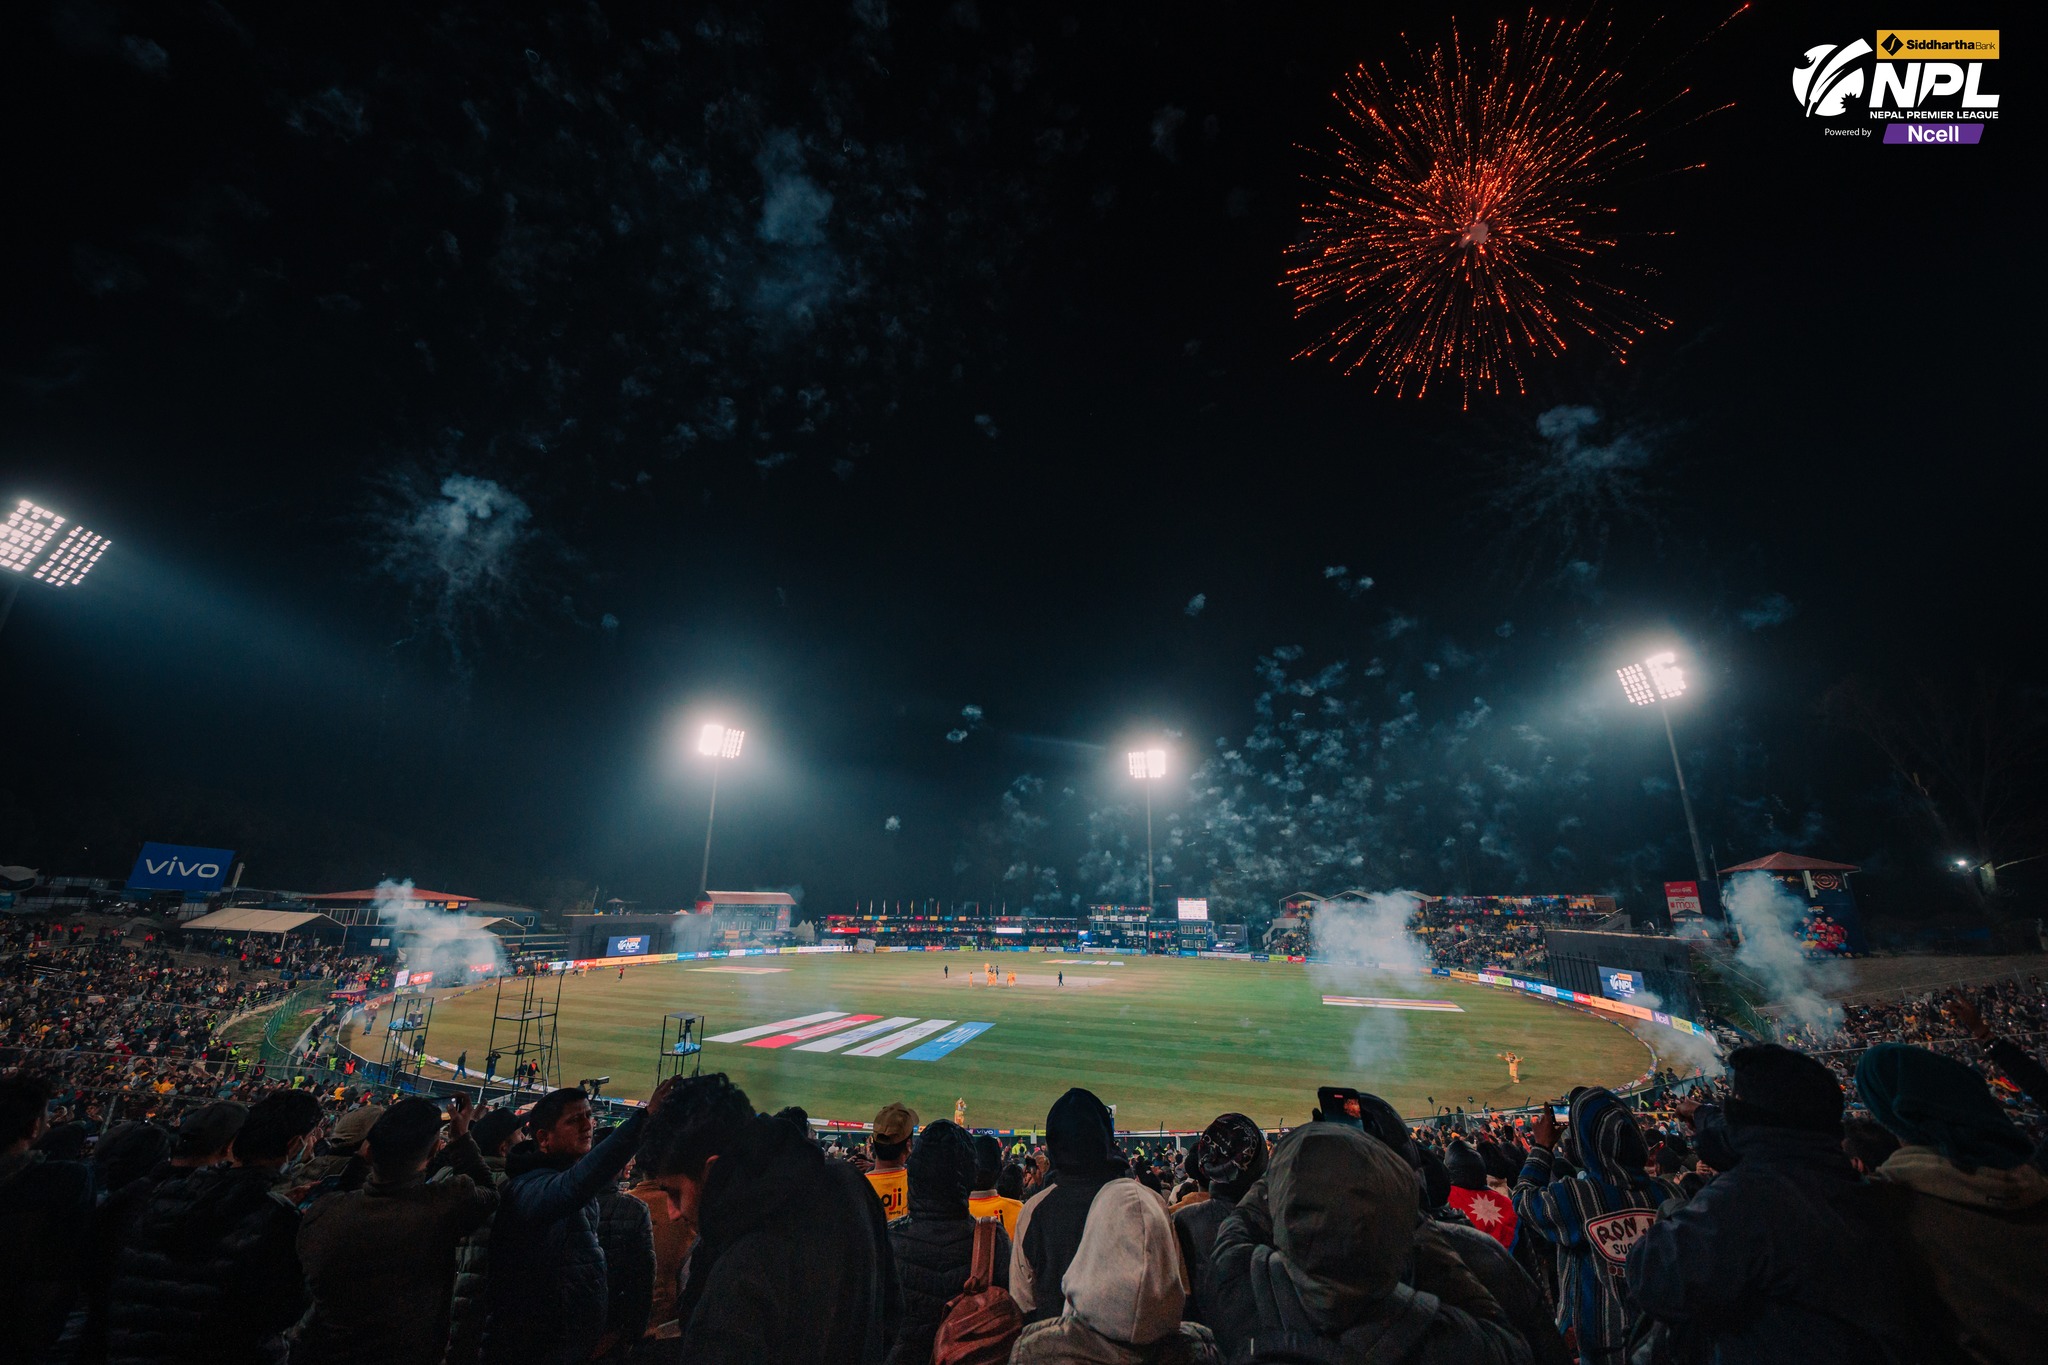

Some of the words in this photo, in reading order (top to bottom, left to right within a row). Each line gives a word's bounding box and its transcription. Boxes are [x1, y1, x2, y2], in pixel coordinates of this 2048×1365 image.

[145, 855, 220, 879] vivo
[1654, 1011, 1670, 1026] Ncell
[881, 1187, 902, 1211] aji
[1596, 1217, 1637, 1245] RON
[1612, 1242, 1633, 1255] SU
